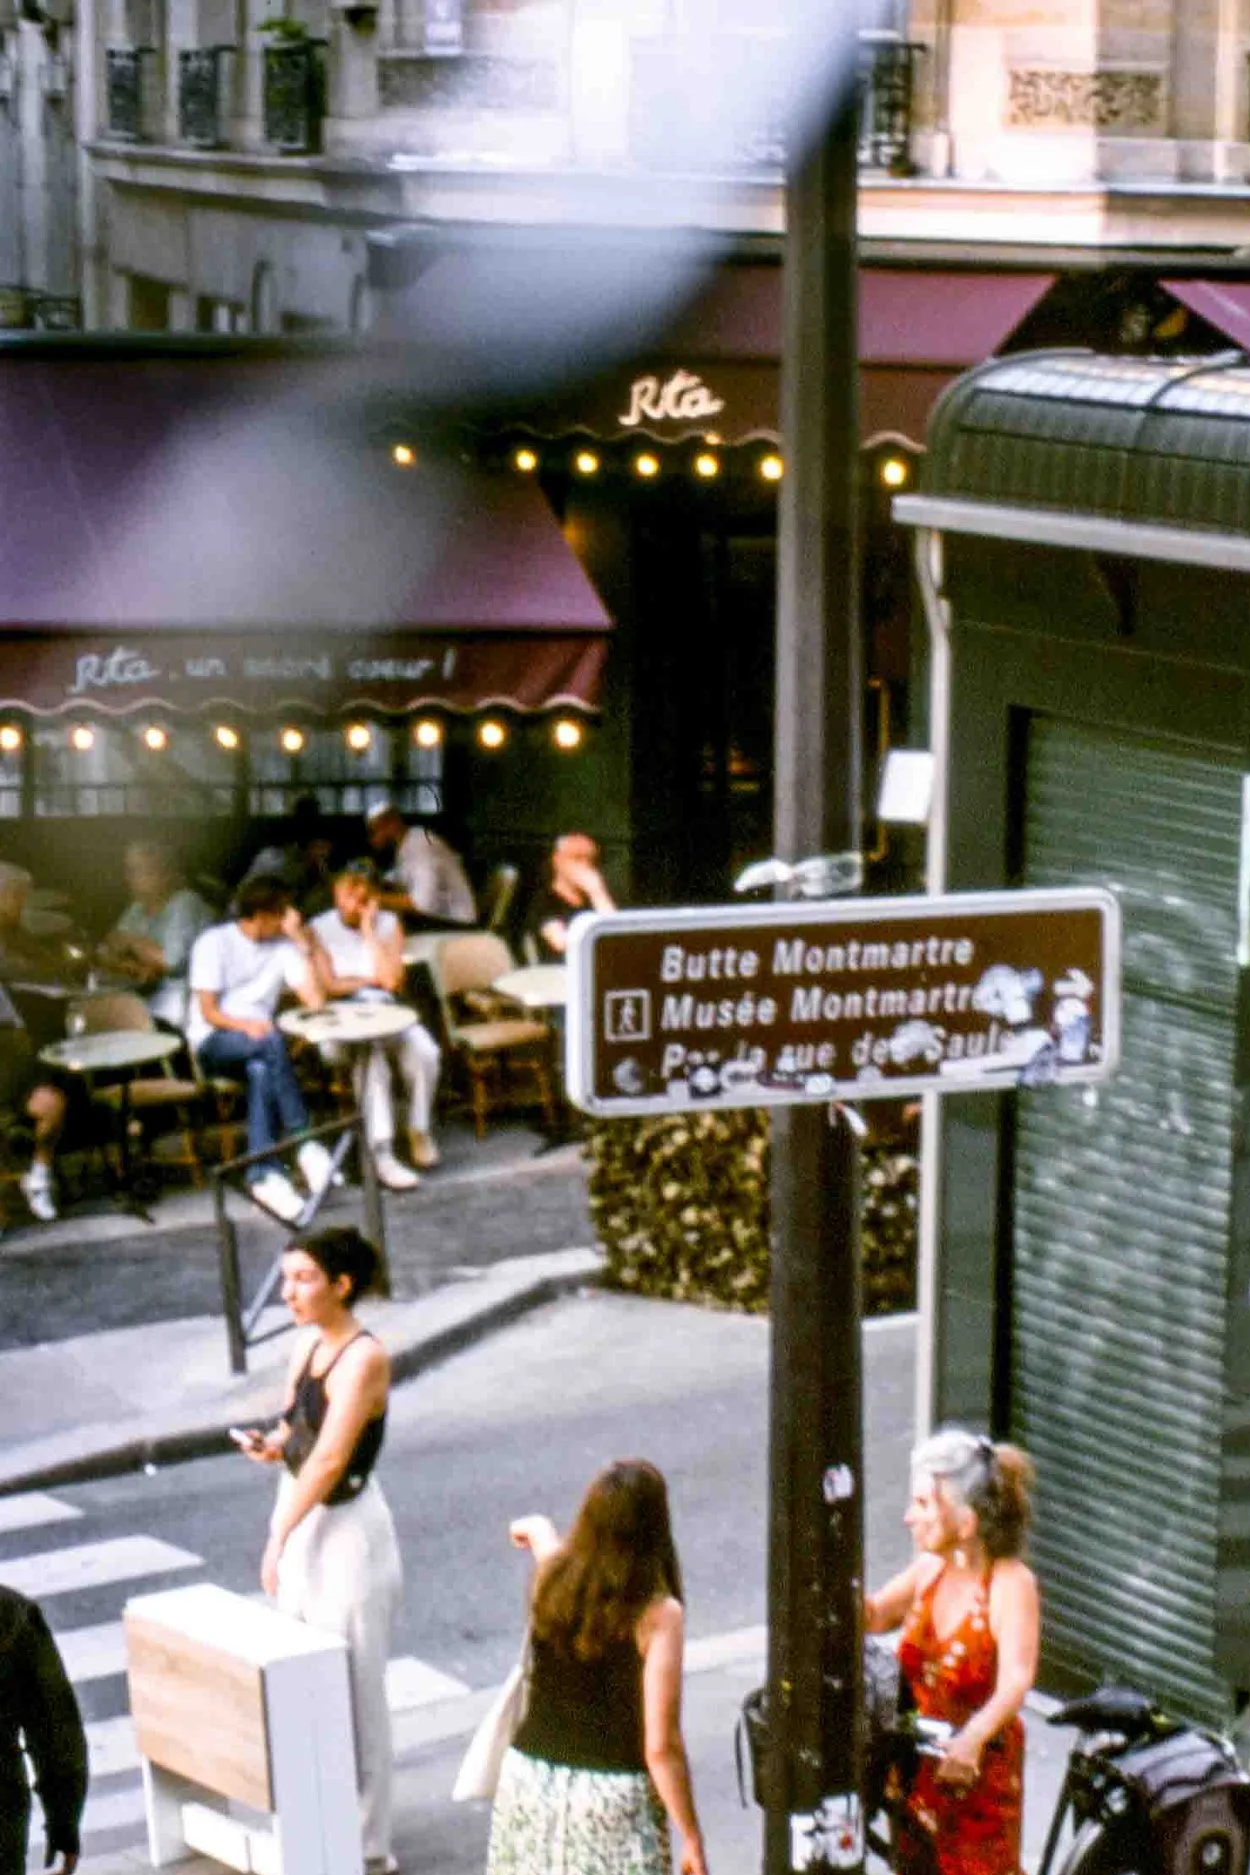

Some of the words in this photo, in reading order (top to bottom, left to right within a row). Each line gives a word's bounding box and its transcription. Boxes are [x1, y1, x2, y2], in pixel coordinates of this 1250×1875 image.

[660, 945, 761, 984] Butte
[772, 936, 975, 976] Montmartre
[660, 990, 778, 1032] Musée
[790, 981, 978, 1024] Montmartr
